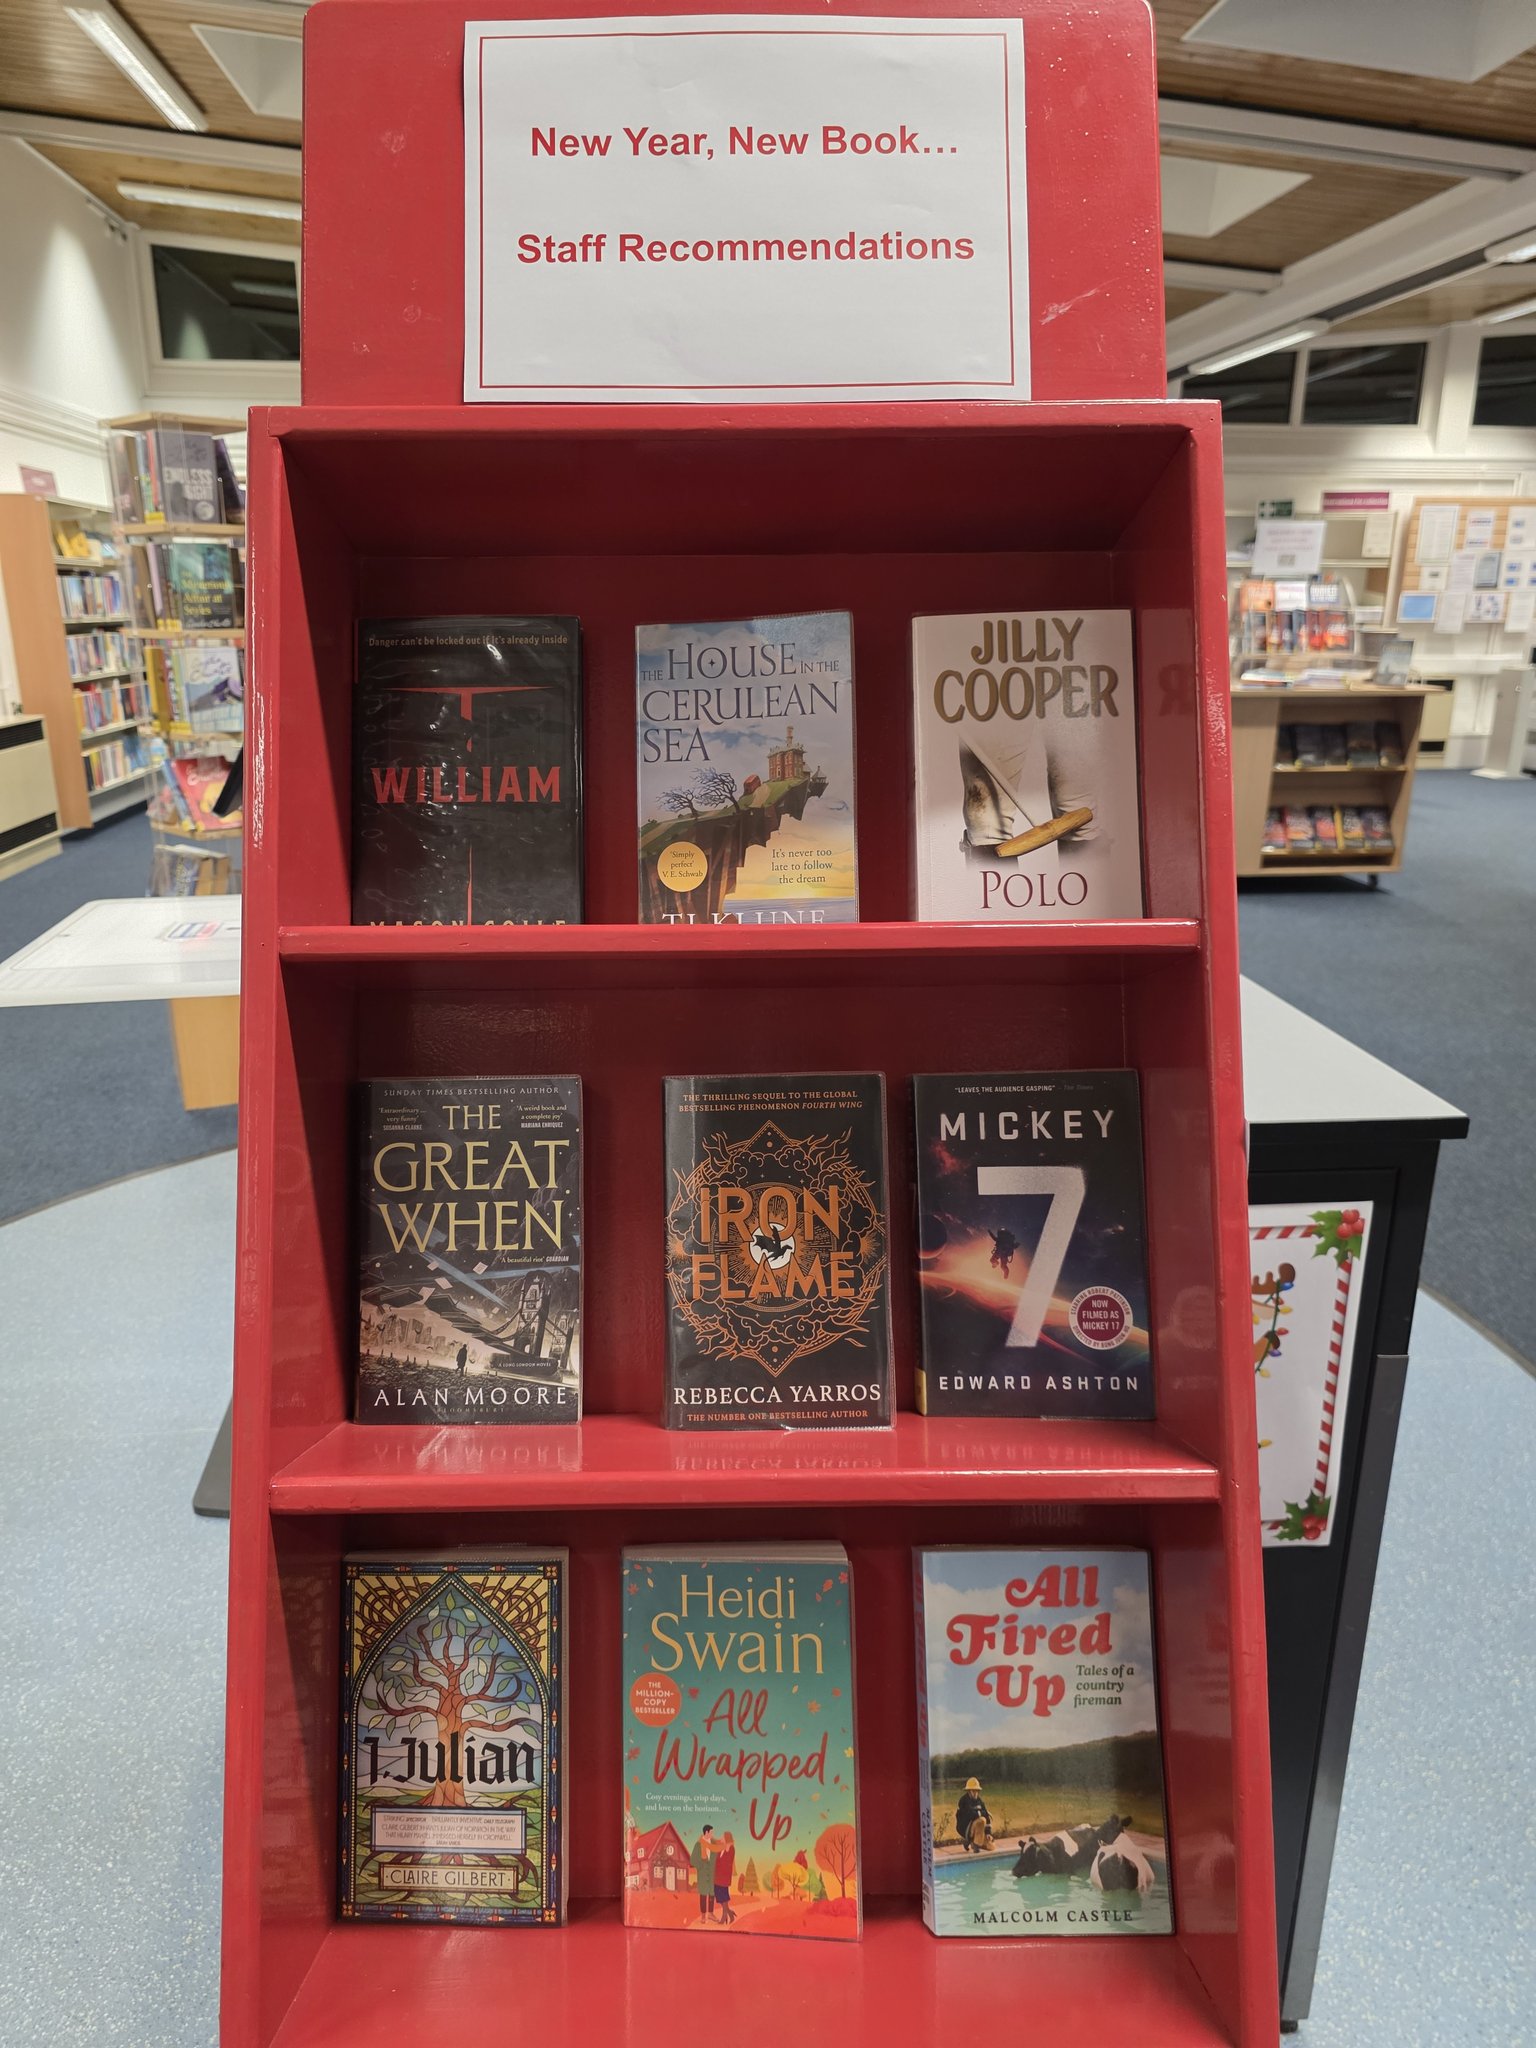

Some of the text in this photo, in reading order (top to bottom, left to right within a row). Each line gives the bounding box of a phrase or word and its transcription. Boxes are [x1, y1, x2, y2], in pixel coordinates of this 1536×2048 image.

[531, 125, 958, 160] New Year, New Book...
[517, 231, 975, 264] Staff Recommendations
[369, 635, 568, 648] Danger can't be locked out if it's already inside
[971, 617, 1084, 665] JILLY
[641, 642, 840, 681] THE HOUSE IN THE
[642, 681, 839, 725] CERULEAN
[934, 664, 1119, 723] COOPER
[643, 727, 711, 764] SEA
[371, 766, 561, 804] WILLIAM
[771, 861, 833, 871] late to follow
[772, 849, 832, 859] It's never too
[678, 870, 704, 878] Schwab
[779, 874, 826, 884] the dream
[980, 870, 1088, 909] POLO
[384, 1089, 422, 1097] SUNDAY
[426, 1088, 453, 1096] TIMES
[457, 1087, 516, 1095] BESTSELLING
[679, 1101, 863, 1112] BESTSELLING PHENOMENON FOURTH WING
[683, 1090, 857, 1102] THE THRILLING SEQUEL TO THE GLOBAL
[442, 1104, 502, 1130] THE
[526, 1112, 551, 1121] complete
[940, 1109, 1114, 1141] MICKEY
[373, 1139, 570, 1192] GREAT
[377, 1200, 565, 1253] WHEN
[700, 1185, 840, 1243] IRON
[977, 1165, 1086, 1347] 7
[691, 1251, 855, 1299] FLAME
[1082, 1311, 1119, 1319] FILMED AS
[1092, 1300, 1108, 1308] NOW
[1083, 1322, 1109, 1330] MICKEY
[1112, 1322, 1119, 1330] 17
[374, 1387, 566, 1406] ALAN MOORE
[674, 1384, 881, 1405] REBECCA YARROS
[939, 1375, 1138, 1391] EDWARD ASHTON
[687, 1410, 868, 1422] THE NUMBER ONE BESTSELLING AUTHOR
[681, 1574, 796, 1619] Heidi
[1004, 1565, 1099, 1608] All
[651, 1612, 824, 1674] Swain
[946, 1613, 1112, 1666] Fired
[1075, 1664, 1135, 1678] Tales of a
[976, 1665, 1066, 1717] Up
[1076, 1679, 1125, 1693] country
[703, 1688, 769, 1738] All
[1073, 1694, 1122, 1708] fireman
[391, 1731, 535, 1784] Julian
[653, 1728, 828, 1793] Wrapped
[645, 1792, 662, 1801] Cosy
[663, 1793, 693, 1802] evenings,
[693, 1794, 710, 1803] crisp
[683, 1804, 694, 1812] the
[749, 1793, 793, 1849] Up
[390, 1870, 506, 1887] CLAIRE GILBERT
[973, 1909, 1133, 1925] MALCOLM CASTLE
